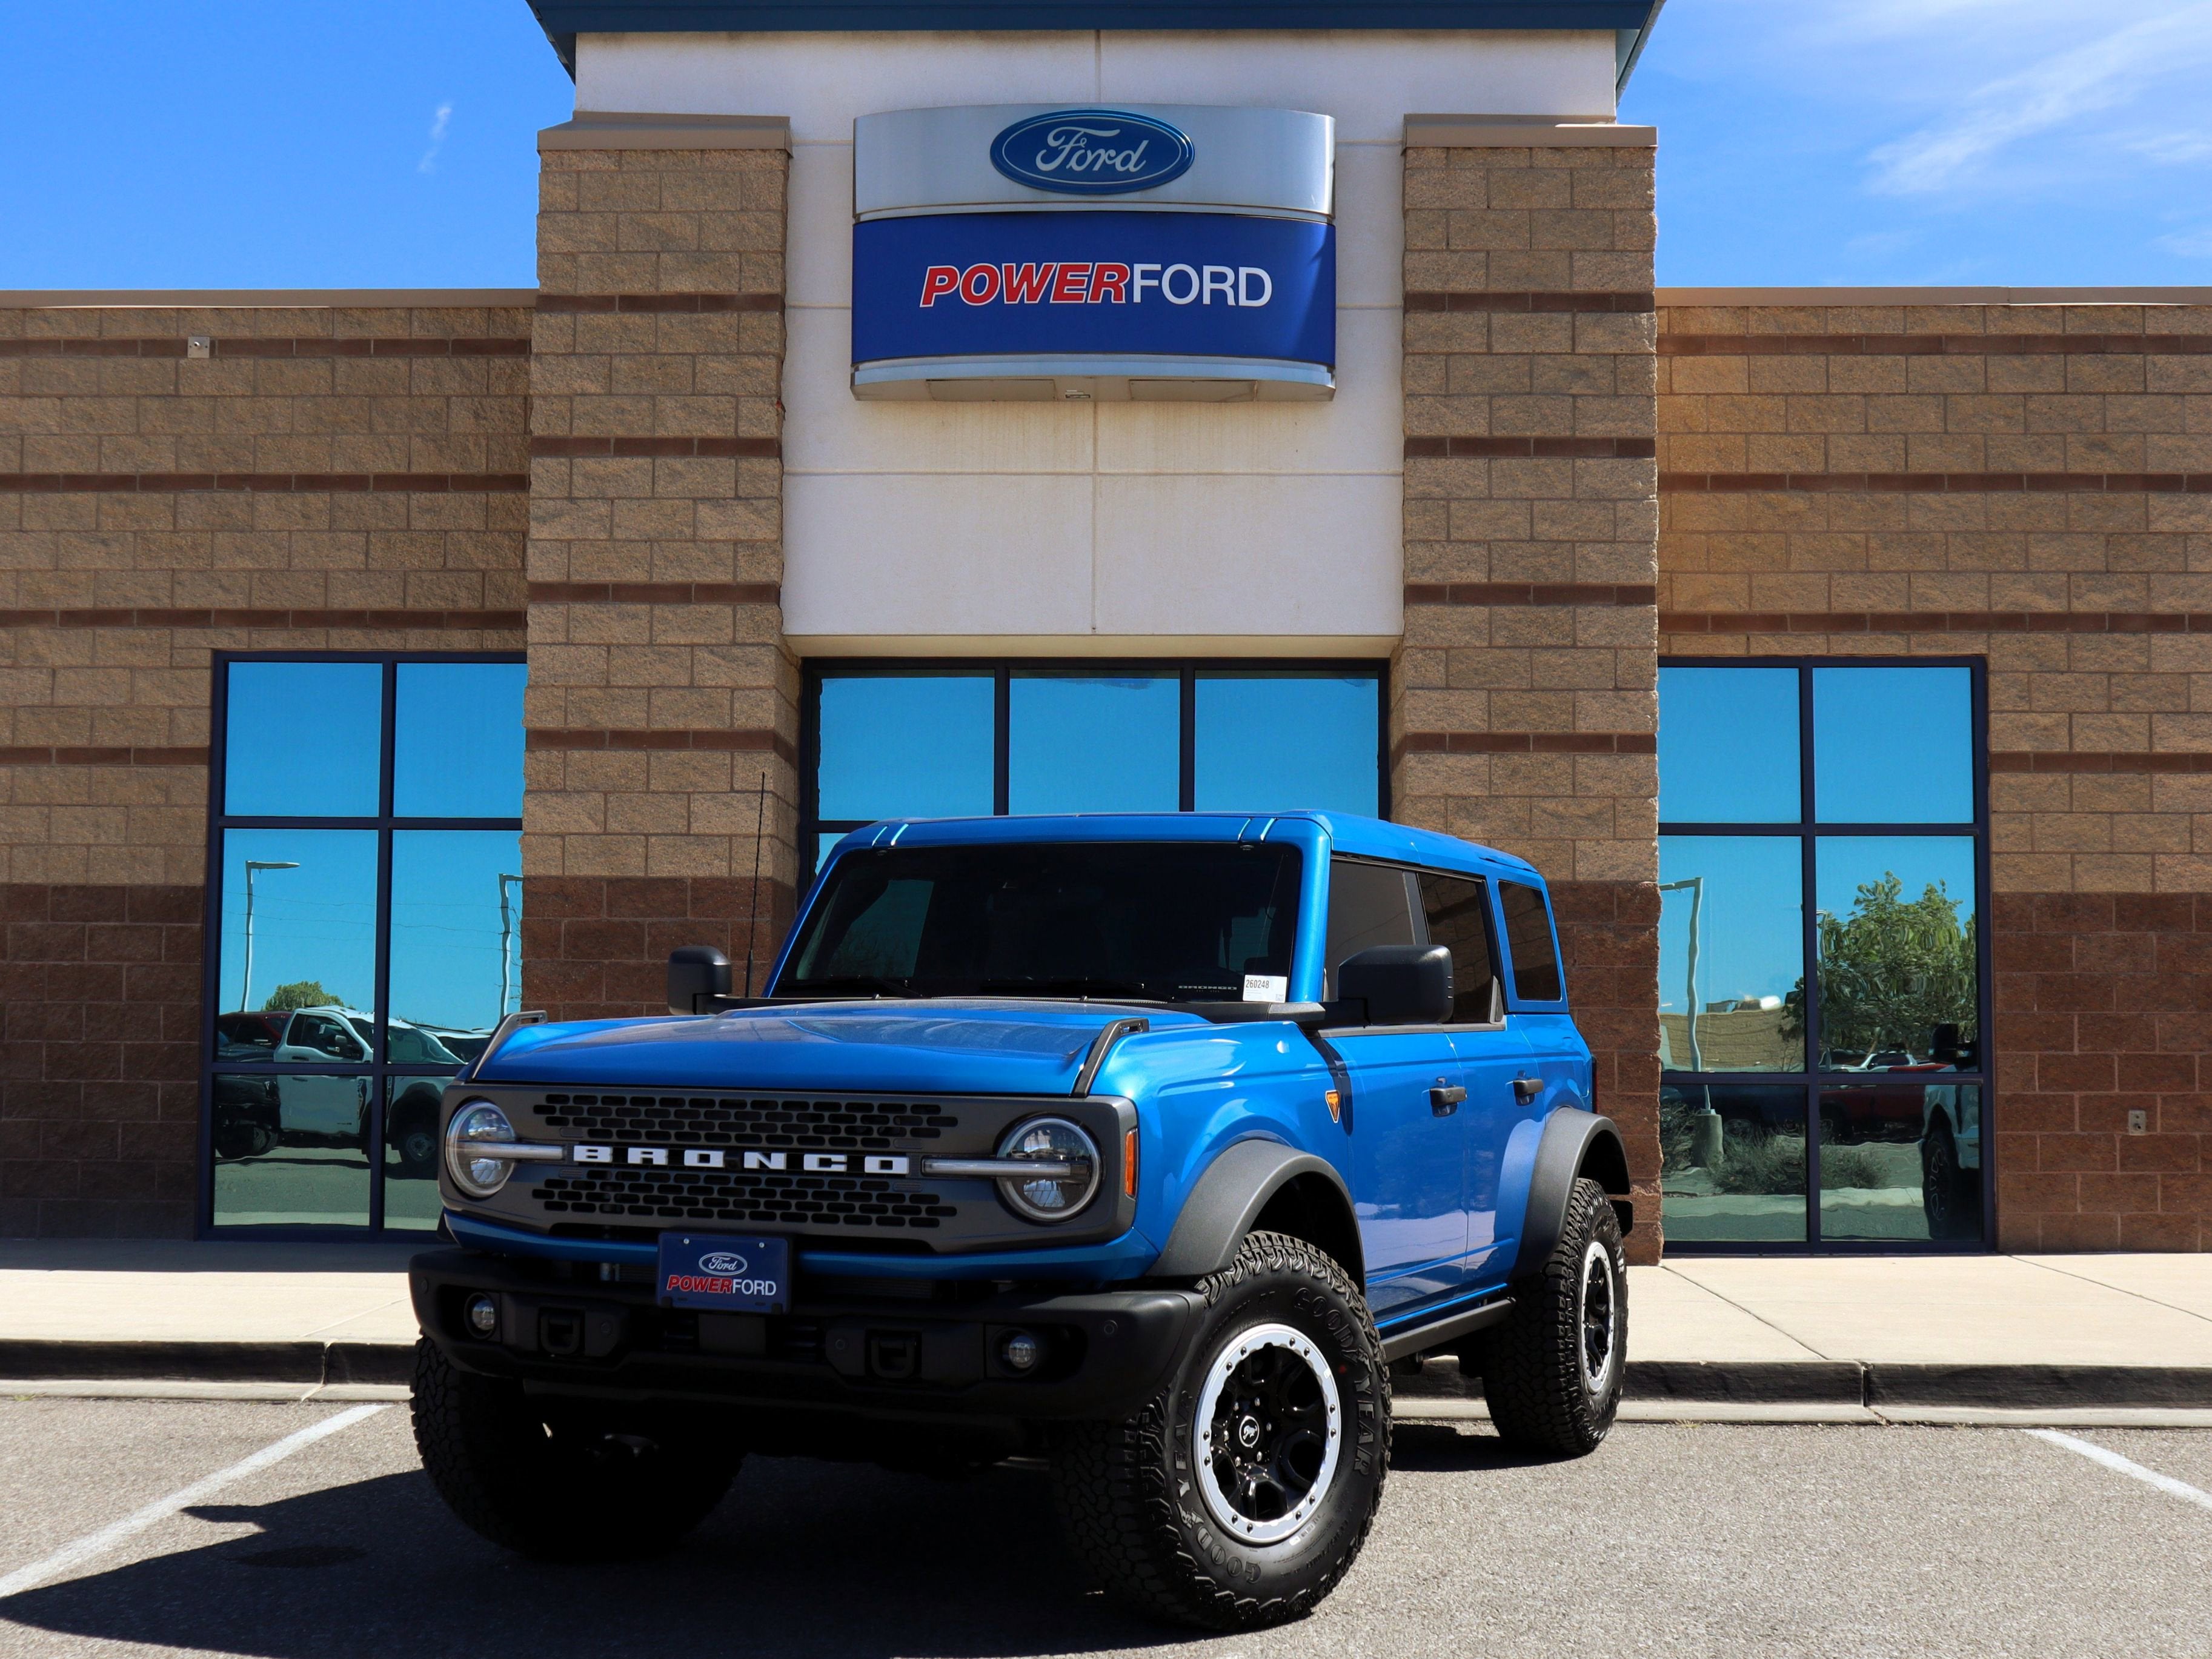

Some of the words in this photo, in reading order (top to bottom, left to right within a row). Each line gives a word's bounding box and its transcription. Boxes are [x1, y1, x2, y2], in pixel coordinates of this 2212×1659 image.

[1035, 126, 1149, 172] Ford
[1246, 979, 1269, 989] 260248
[573, 1145, 909, 1174] BRONCO
[708, 1256, 738, 1271] Ford
